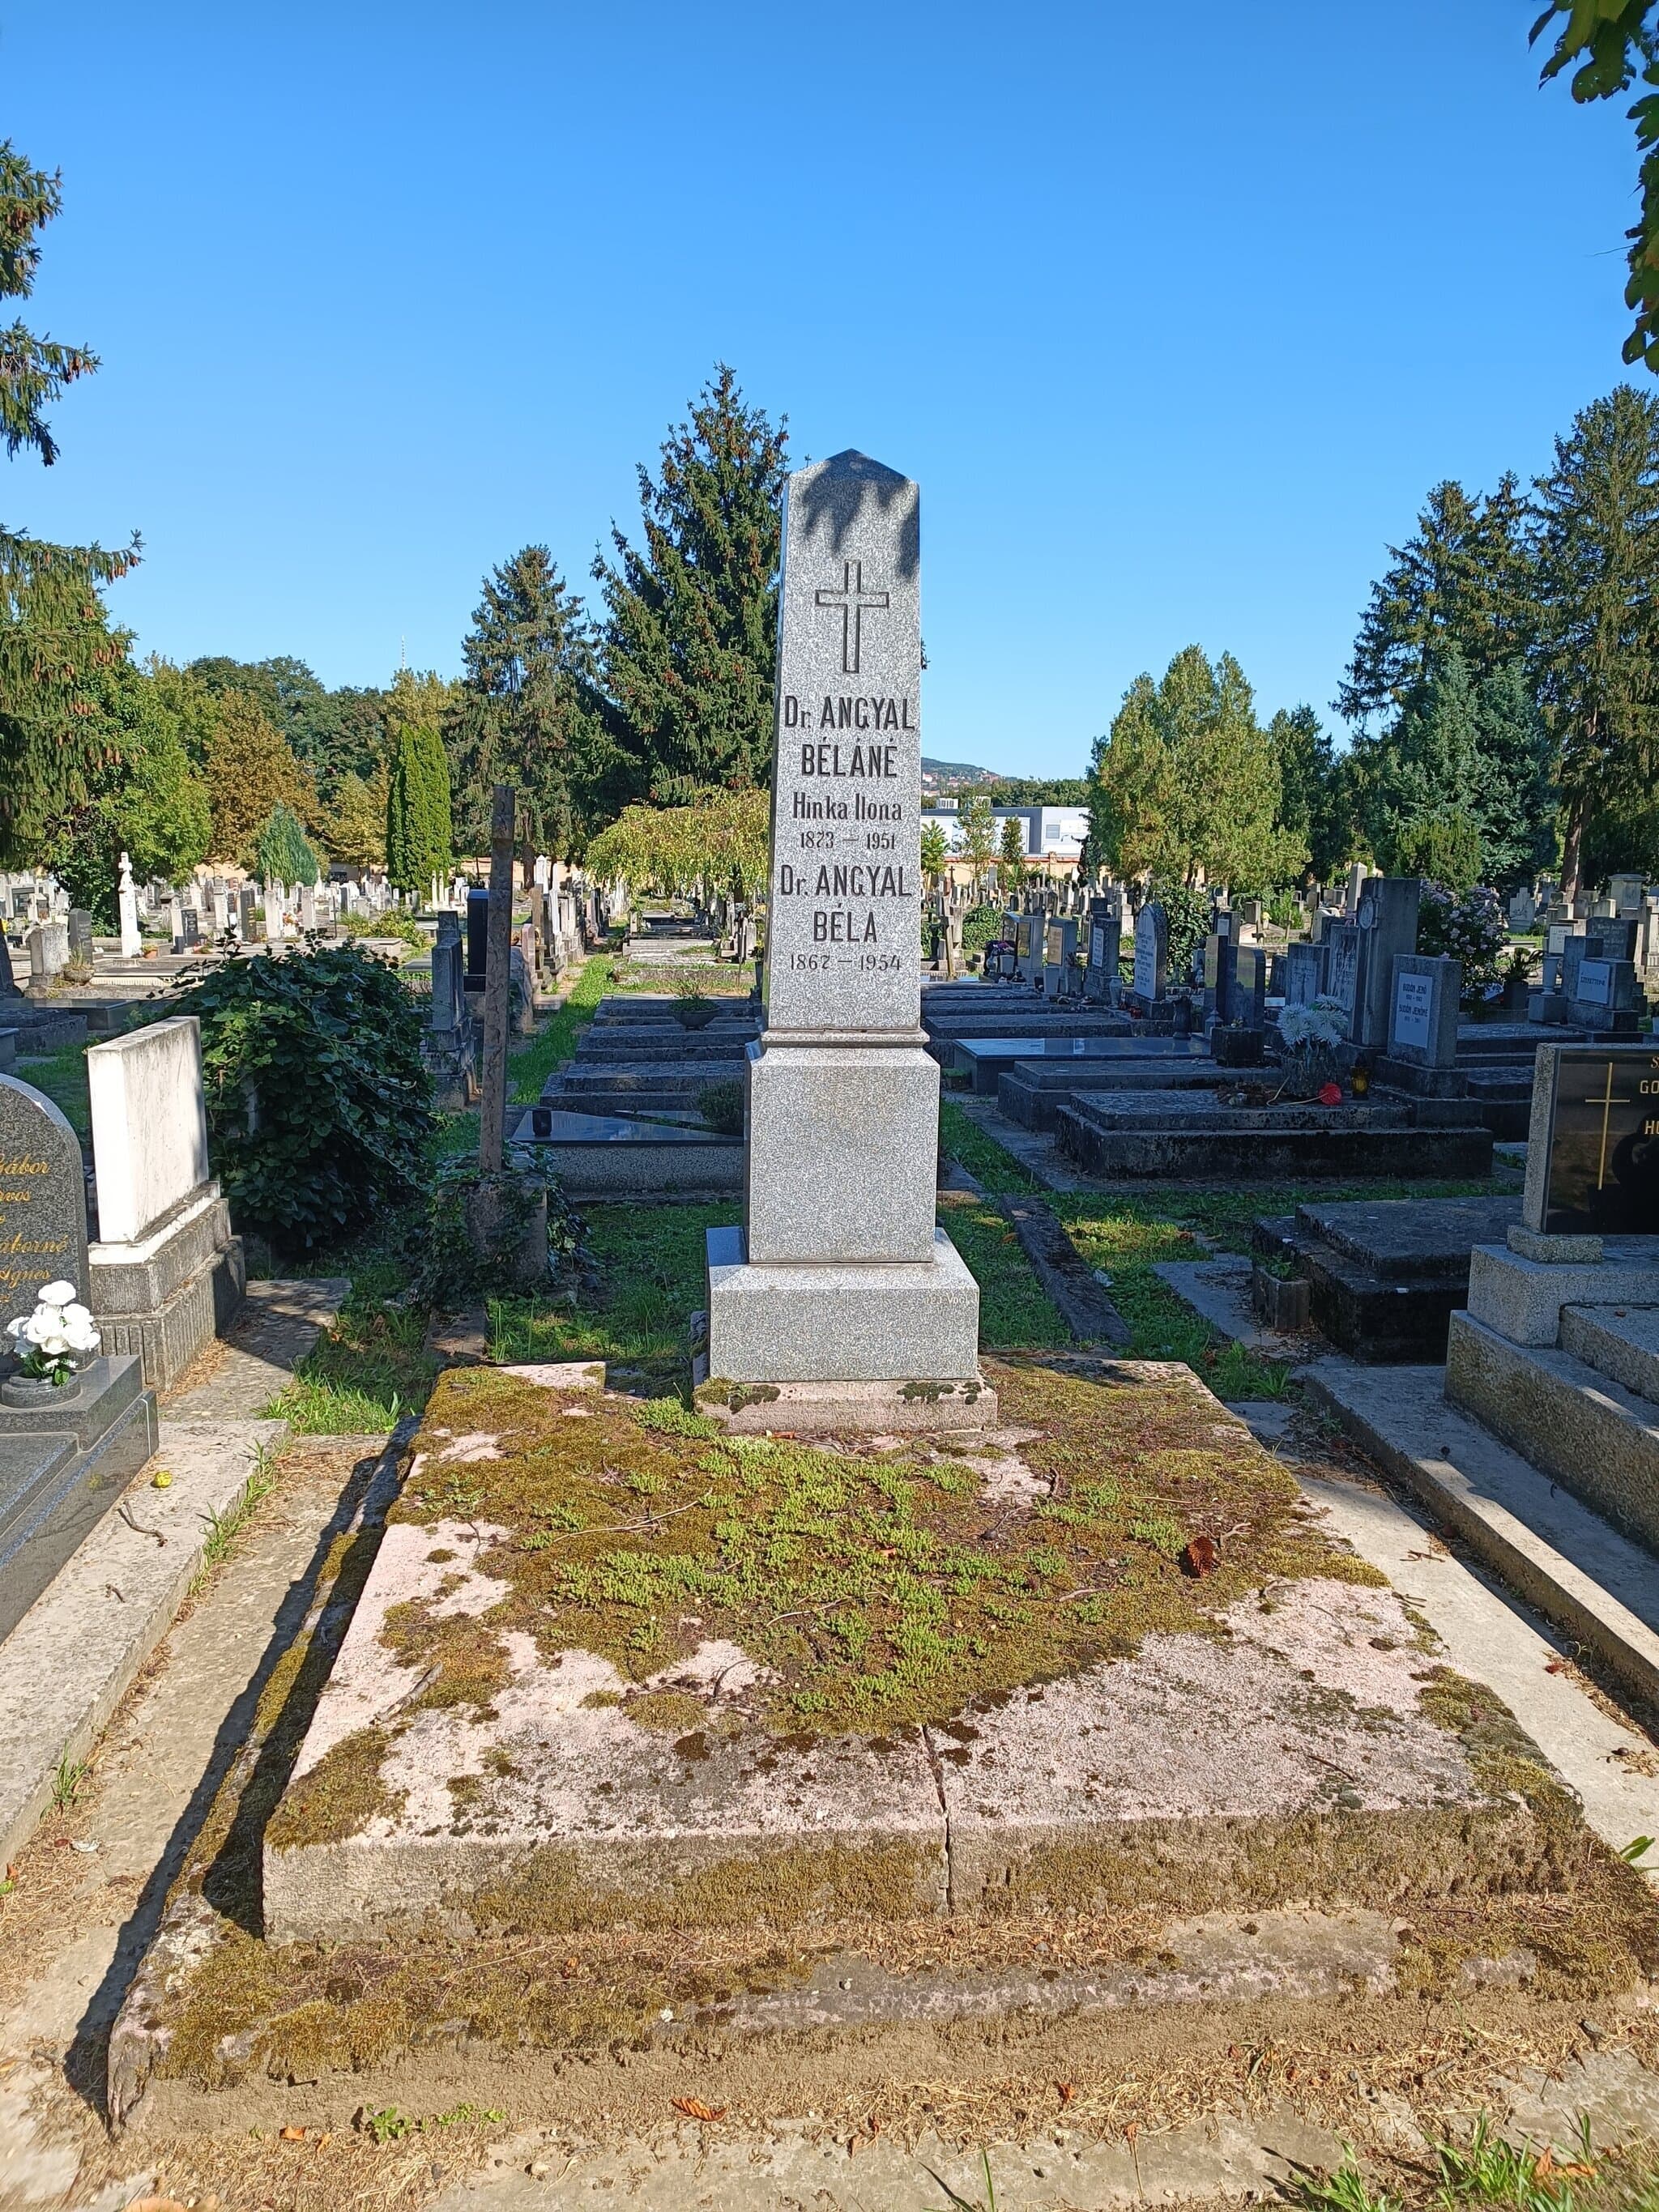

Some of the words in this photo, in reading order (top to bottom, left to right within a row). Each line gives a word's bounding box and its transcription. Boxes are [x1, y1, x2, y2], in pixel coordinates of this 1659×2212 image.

[784, 696, 811, 728] Dr.
[820, 697, 915, 731] ANGYAL
[802, 736, 898, 778] BÉLÁNÉ
[792, 791, 848, 820] Hinka
[855, 793, 902, 820] Ilona
[800, 831, 834, 849] 1873
[867, 833, 896, 850] 1951
[781, 864, 808, 896] Dr.
[816, 865, 912, 897] ANGYAL
[813, 903, 877, 943] BÉLA
[860, 954, 901, 970] 1954
